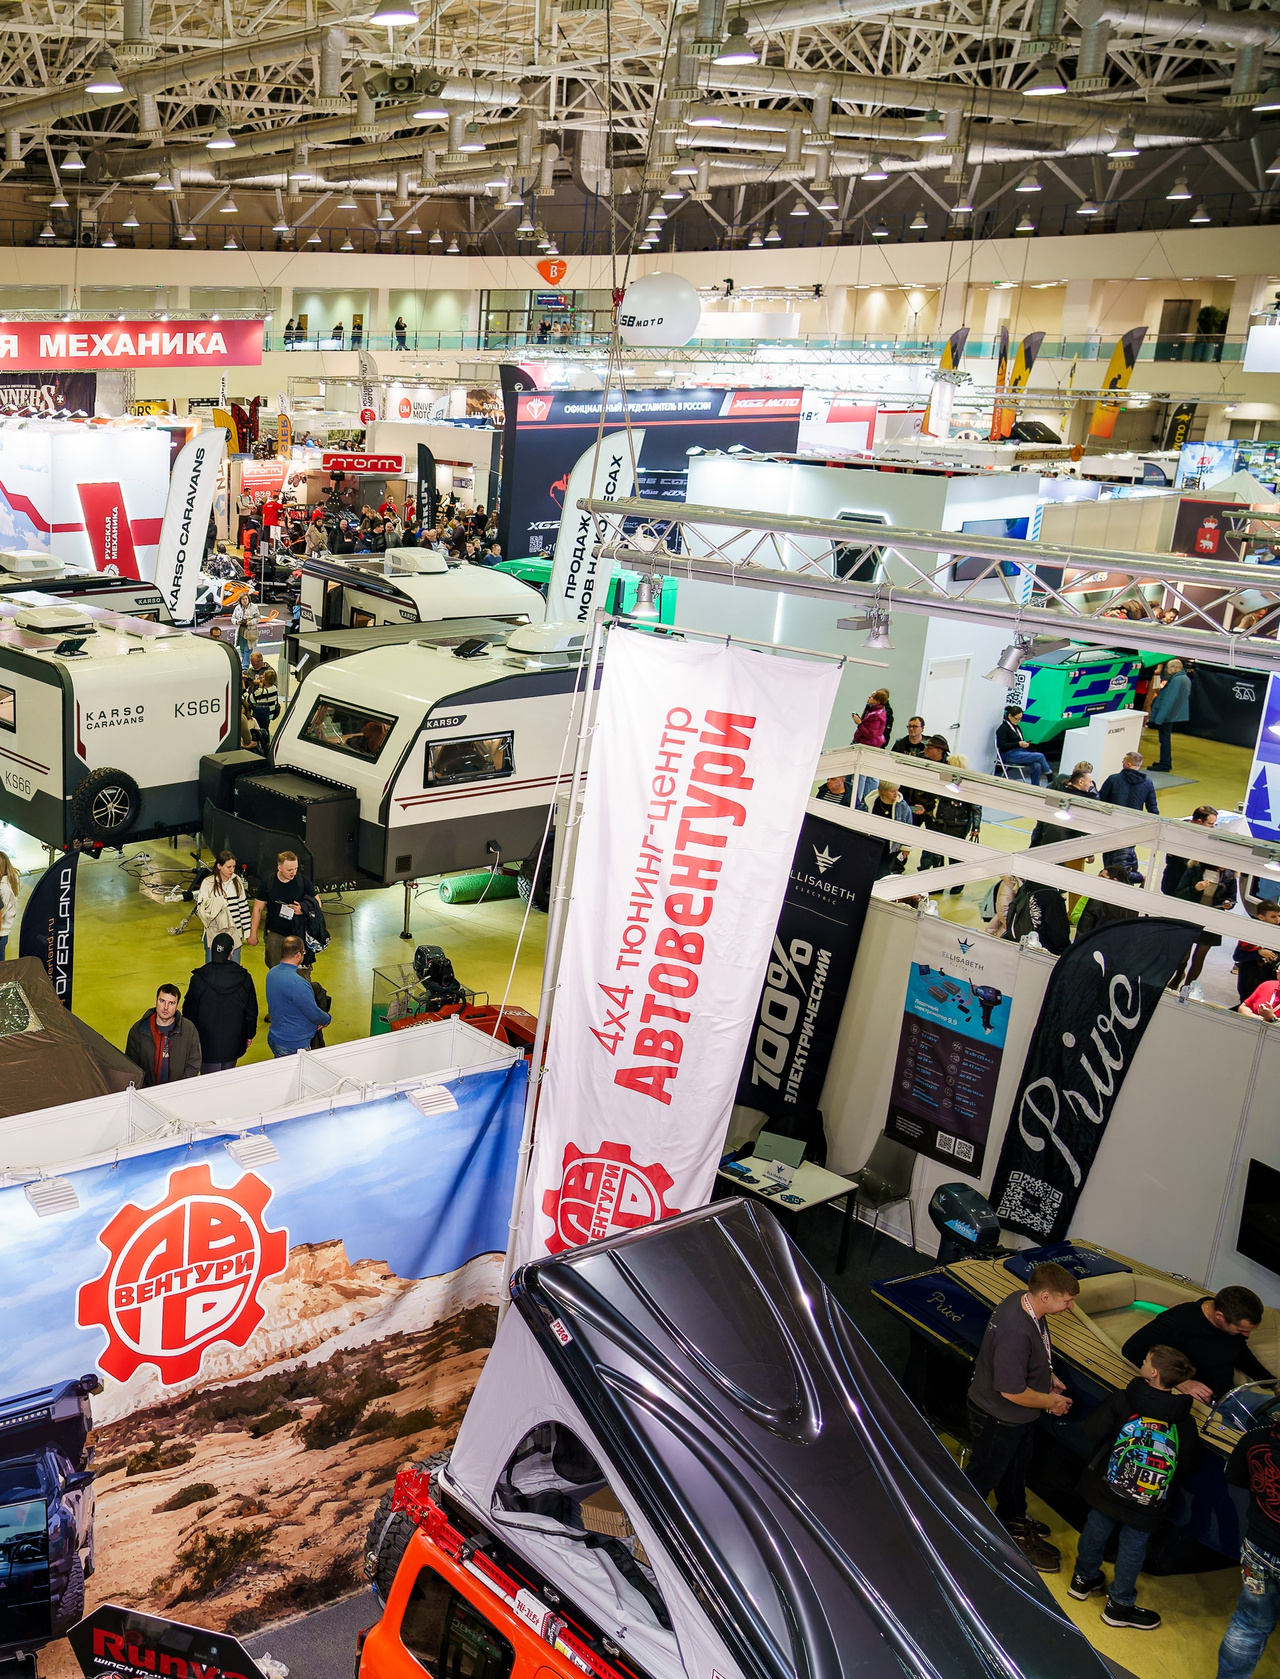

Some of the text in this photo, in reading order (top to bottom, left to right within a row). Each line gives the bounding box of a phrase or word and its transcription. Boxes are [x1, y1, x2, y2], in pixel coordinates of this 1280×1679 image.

[636, 318, 664, 327] MOTO
[39, 332, 229, 358] МЕХАНИКА
[683, 401, 712, 411] РОССИИ
[169, 447, 205, 612] KARSO CARAVANS
[577, 455, 623, 623] МОВ КОЕСАХ
[565, 511, 592, 599] ПРОДАЖ
[400, 610, 417, 621] KARSO
[86, 705, 145, 721] KARSO
[174, 698, 221, 718] KS66
[86, 716, 144, 730] CARAVANS
[426, 717, 459, 728] KARSO
[5, 770, 32, 796] KS66
[795, 885, 837, 906] ELECTRIC
[56, 867, 72, 995] OVERLAND
[941, 950, 985, 971] ELLISABETH
[751, 933, 814, 1091] 100%
[783, 948, 833, 1105] ЭЛЕКТРИЧЕСКИЙ
[590, 1164, 622, 1243] ЕНТУРИ
[114, 1252, 257, 1310] ВЕНТУРИ
[553, 1321, 570, 1343] РИФ
[516, 1598, 541, 1627] Hi-Lift
[93, 1656, 134, 1674] WINCH
